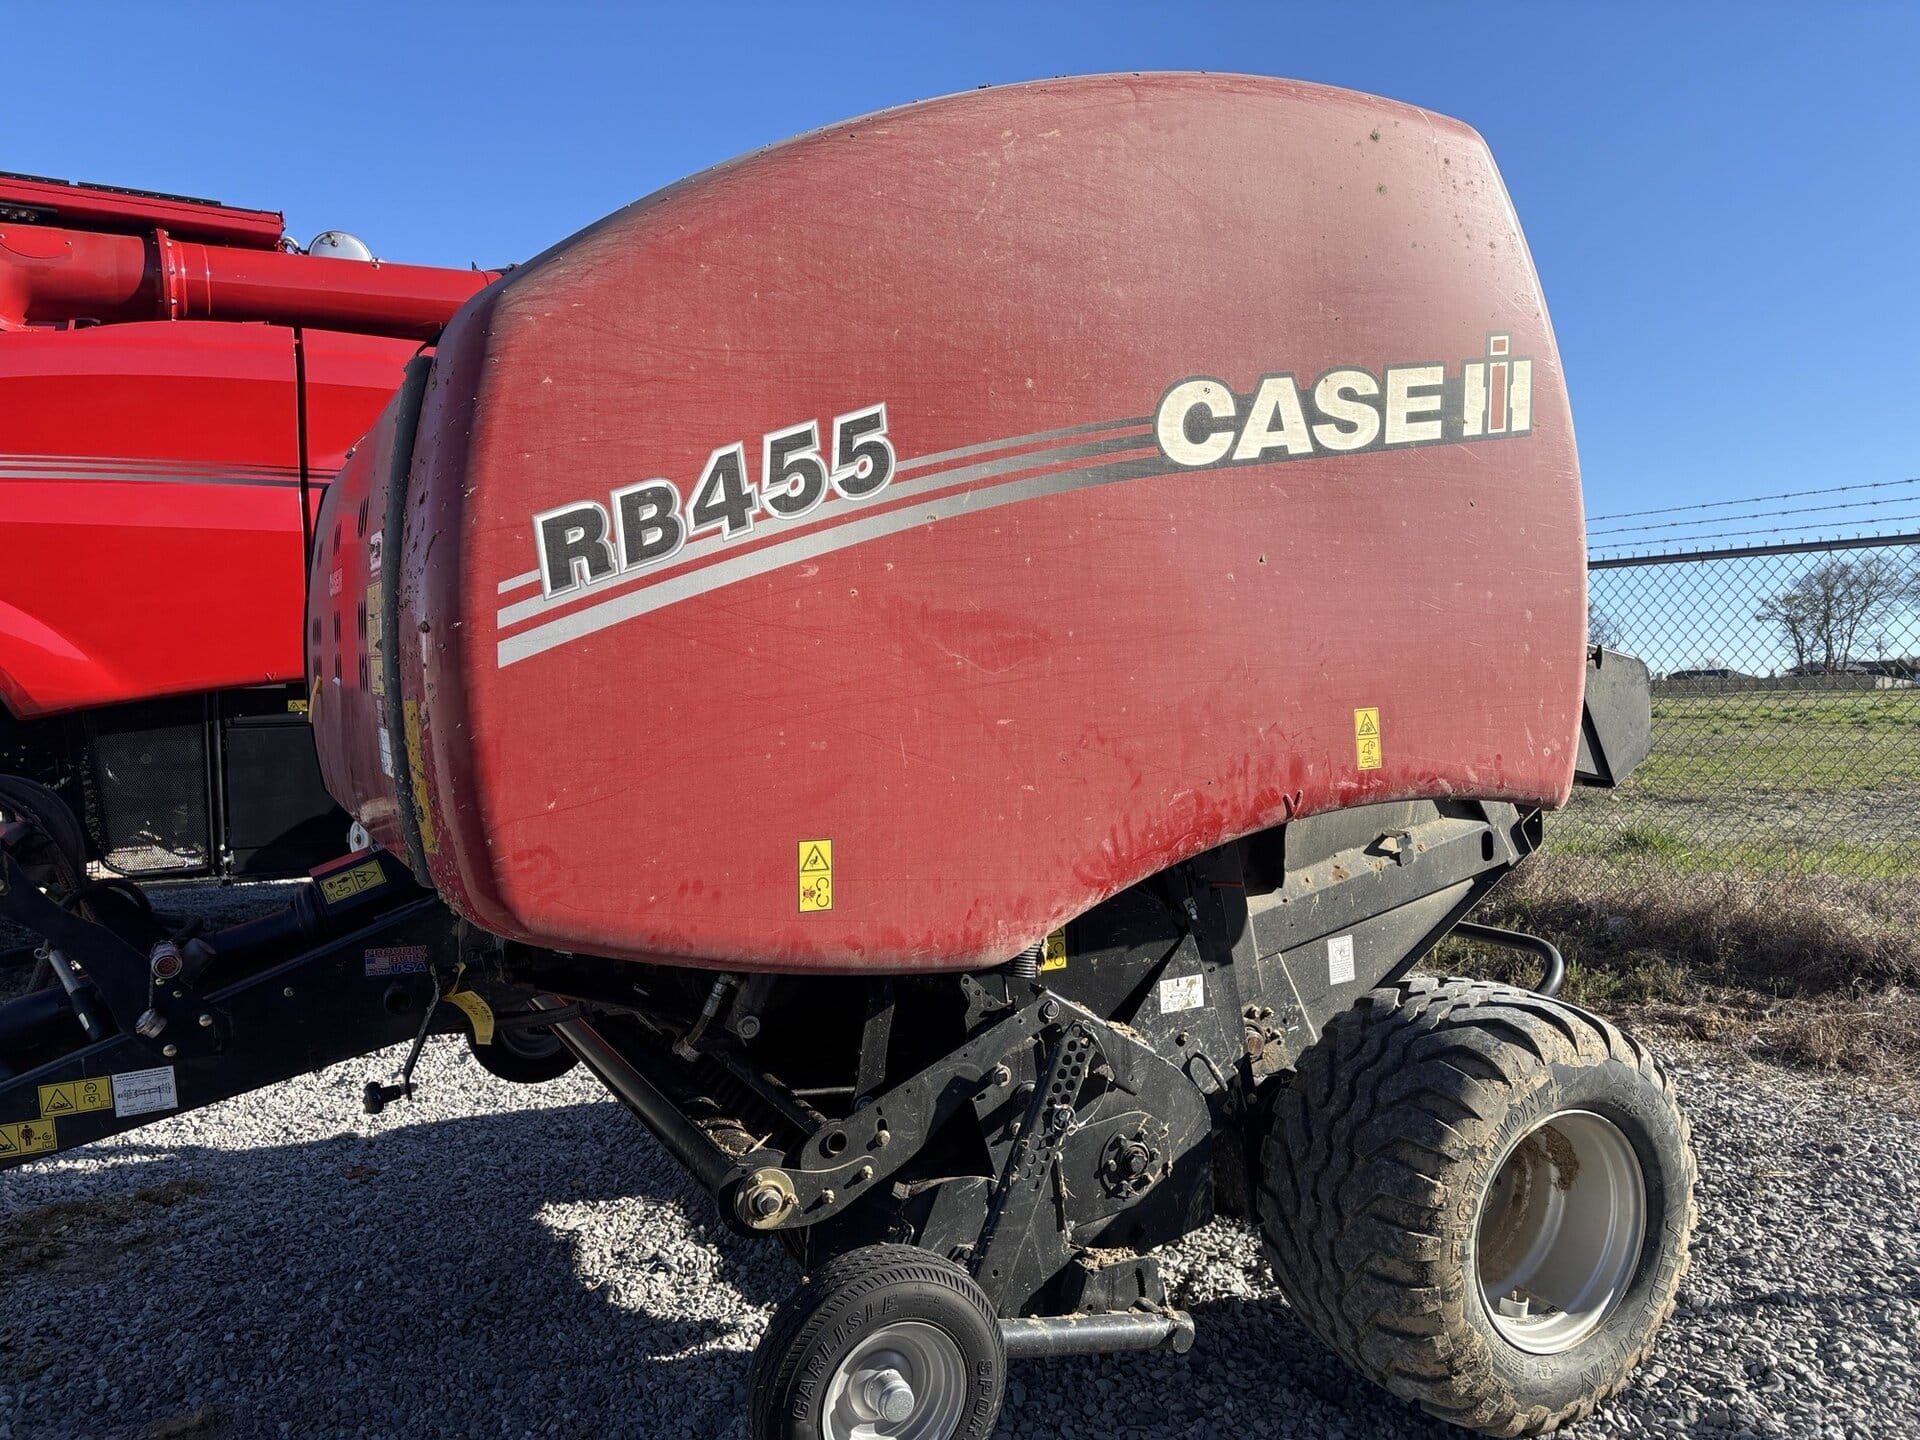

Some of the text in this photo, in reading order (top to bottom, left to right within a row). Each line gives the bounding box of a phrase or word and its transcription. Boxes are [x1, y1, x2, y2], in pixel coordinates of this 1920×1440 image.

[1157, 365, 1445, 466] CASE
[532, 401, 897, 600] RB455
[365, 945, 427, 958] PROUDLY
[390, 962, 428, 974] USA
[792, 1294, 898, 1421] CARLISLE
[963, 1358, 993, 1440] SPOR
